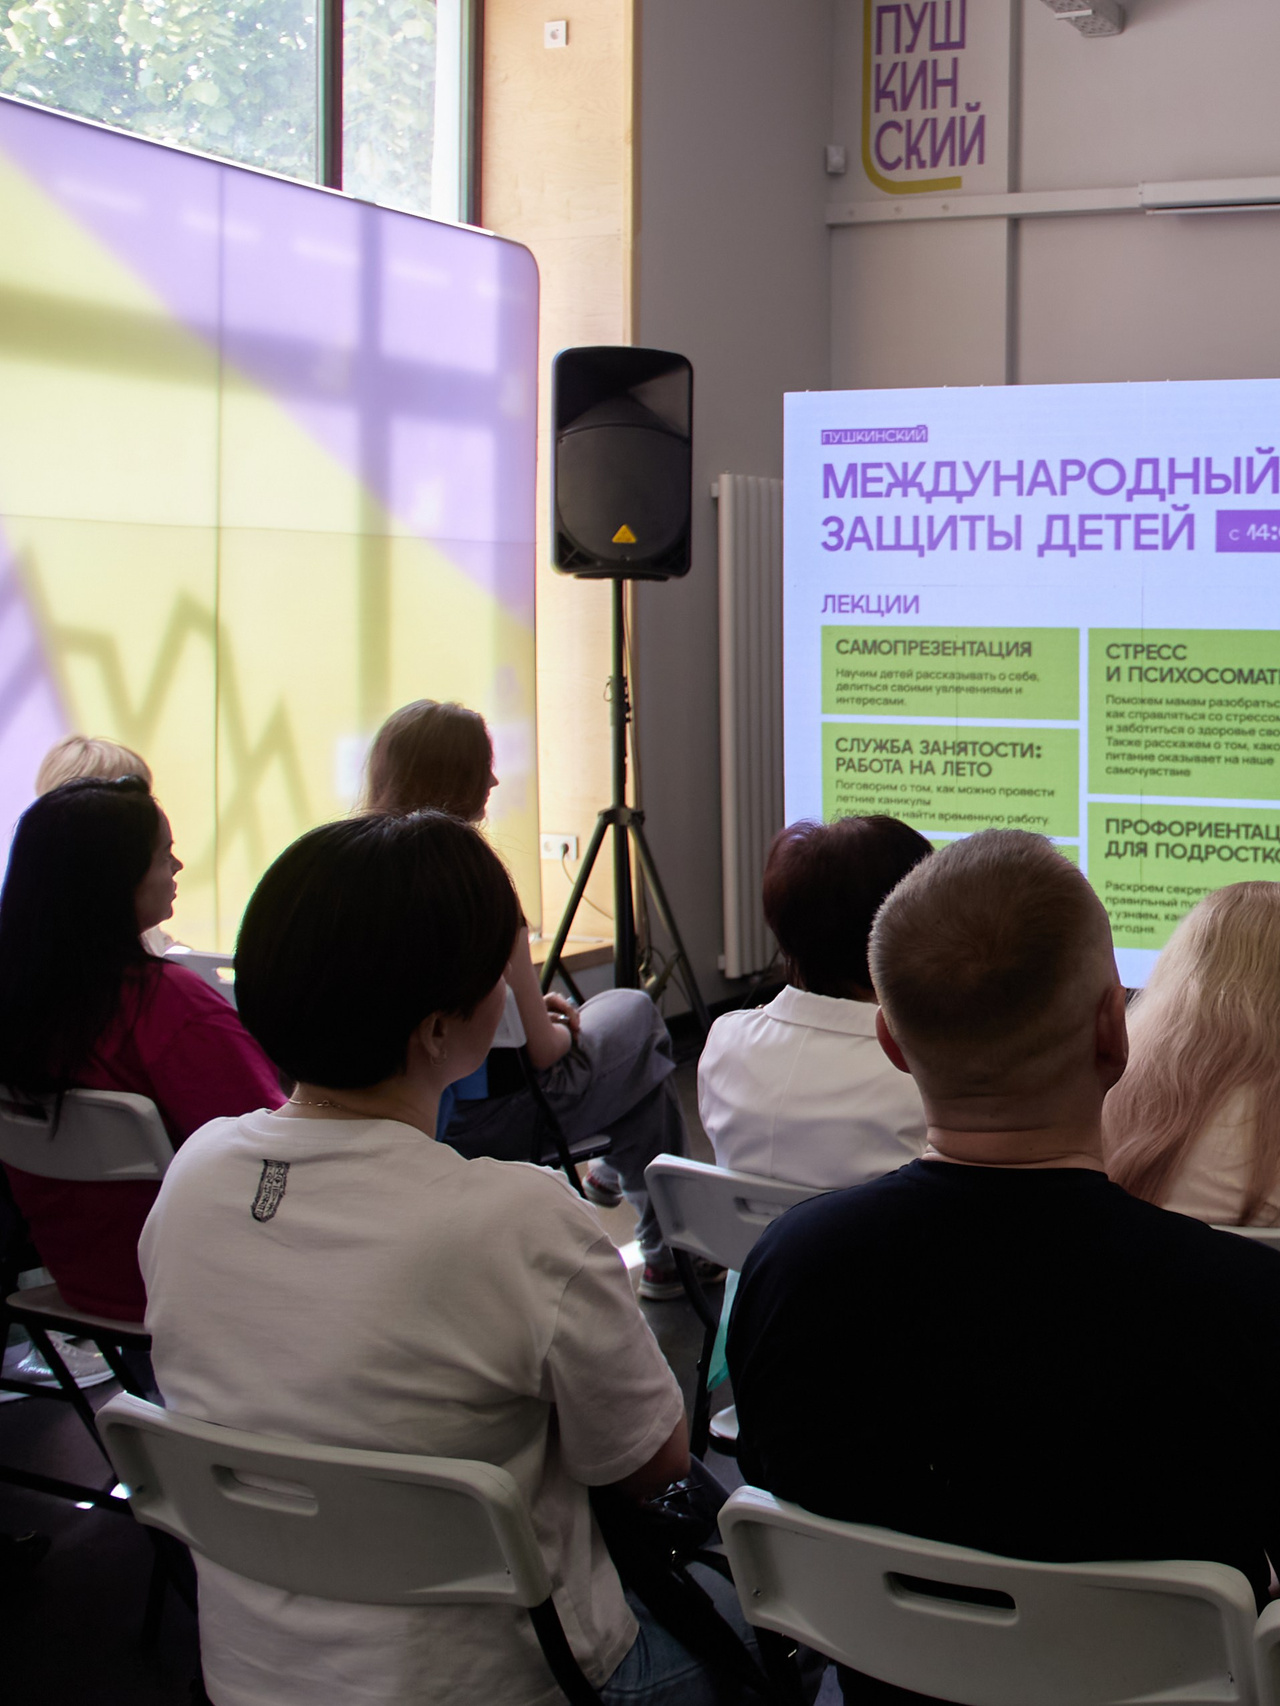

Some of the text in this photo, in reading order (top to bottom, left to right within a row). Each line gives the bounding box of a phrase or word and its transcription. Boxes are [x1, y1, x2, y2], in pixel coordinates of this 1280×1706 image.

[875, 0, 966, 55] ПУШ
[874, 57, 958, 113] КИН
[874, 101, 985, 171] СКИЙ
[821, 426, 927, 443] ПУШКИНСКИЙ
[822, 447, 1280, 503] МЕЖДУНАРОДНЫЙ
[821, 504, 1195, 557] ЗАЩИТЫ ДЕТЕЙ
[821, 595, 920, 617] ЛЕКЦИИ
[835, 638, 1032, 659] САМОПРЕЗЕНТАЦИЯ
[1105, 643, 1187, 661] СТРЕСС
[835, 668, 877, 680] Научим
[879, 669, 913, 681] детей
[915, 670, 996, 682] рассказывать
[998, 673, 1006, 681] о
[1105, 666, 1121, 682] И
[835, 682, 1023, 696] делиться своими увлечениями и
[1105, 694, 1163, 706] Поможем
[1165, 697, 1206, 706] мамам
[1105, 710, 1125, 719] как
[1128, 711, 1206, 722] справляться
[1208, 712, 1223, 722] со
[1105, 723, 1113, 732] и
[1116, 722, 1185, 734] заботиться
[1187, 726, 1195, 735] о
[1197, 726, 1256, 738] здоровье
[835, 737, 1042, 759] СЛУЖБА ЗАНЯТОСТИ:
[1106, 737, 1142, 748] Также
[1144, 738, 1211, 751] расскажем
[1213, 740, 1221, 750] о
[1105, 751, 1274, 765] питание оказывает на наше
[835, 757, 992, 778] РАБОТА НА ЛЕТО
[1105, 765, 1191, 778] самочувствие
[835, 779, 897, 793] Поговорим
[900, 784, 907, 792] о
[936, 785, 955, 794] как
[957, 786, 996, 796] можно
[998, 786, 1055, 799] провести
[835, 795, 931, 807] летние каникулы
[902, 808, 936, 820] найти
[938, 811, 1005, 823] временную
[1105, 840, 1148, 859] ДЛЯ
[1105, 880, 1163, 893] Раскроем
[1105, 896, 1177, 908] правильный
